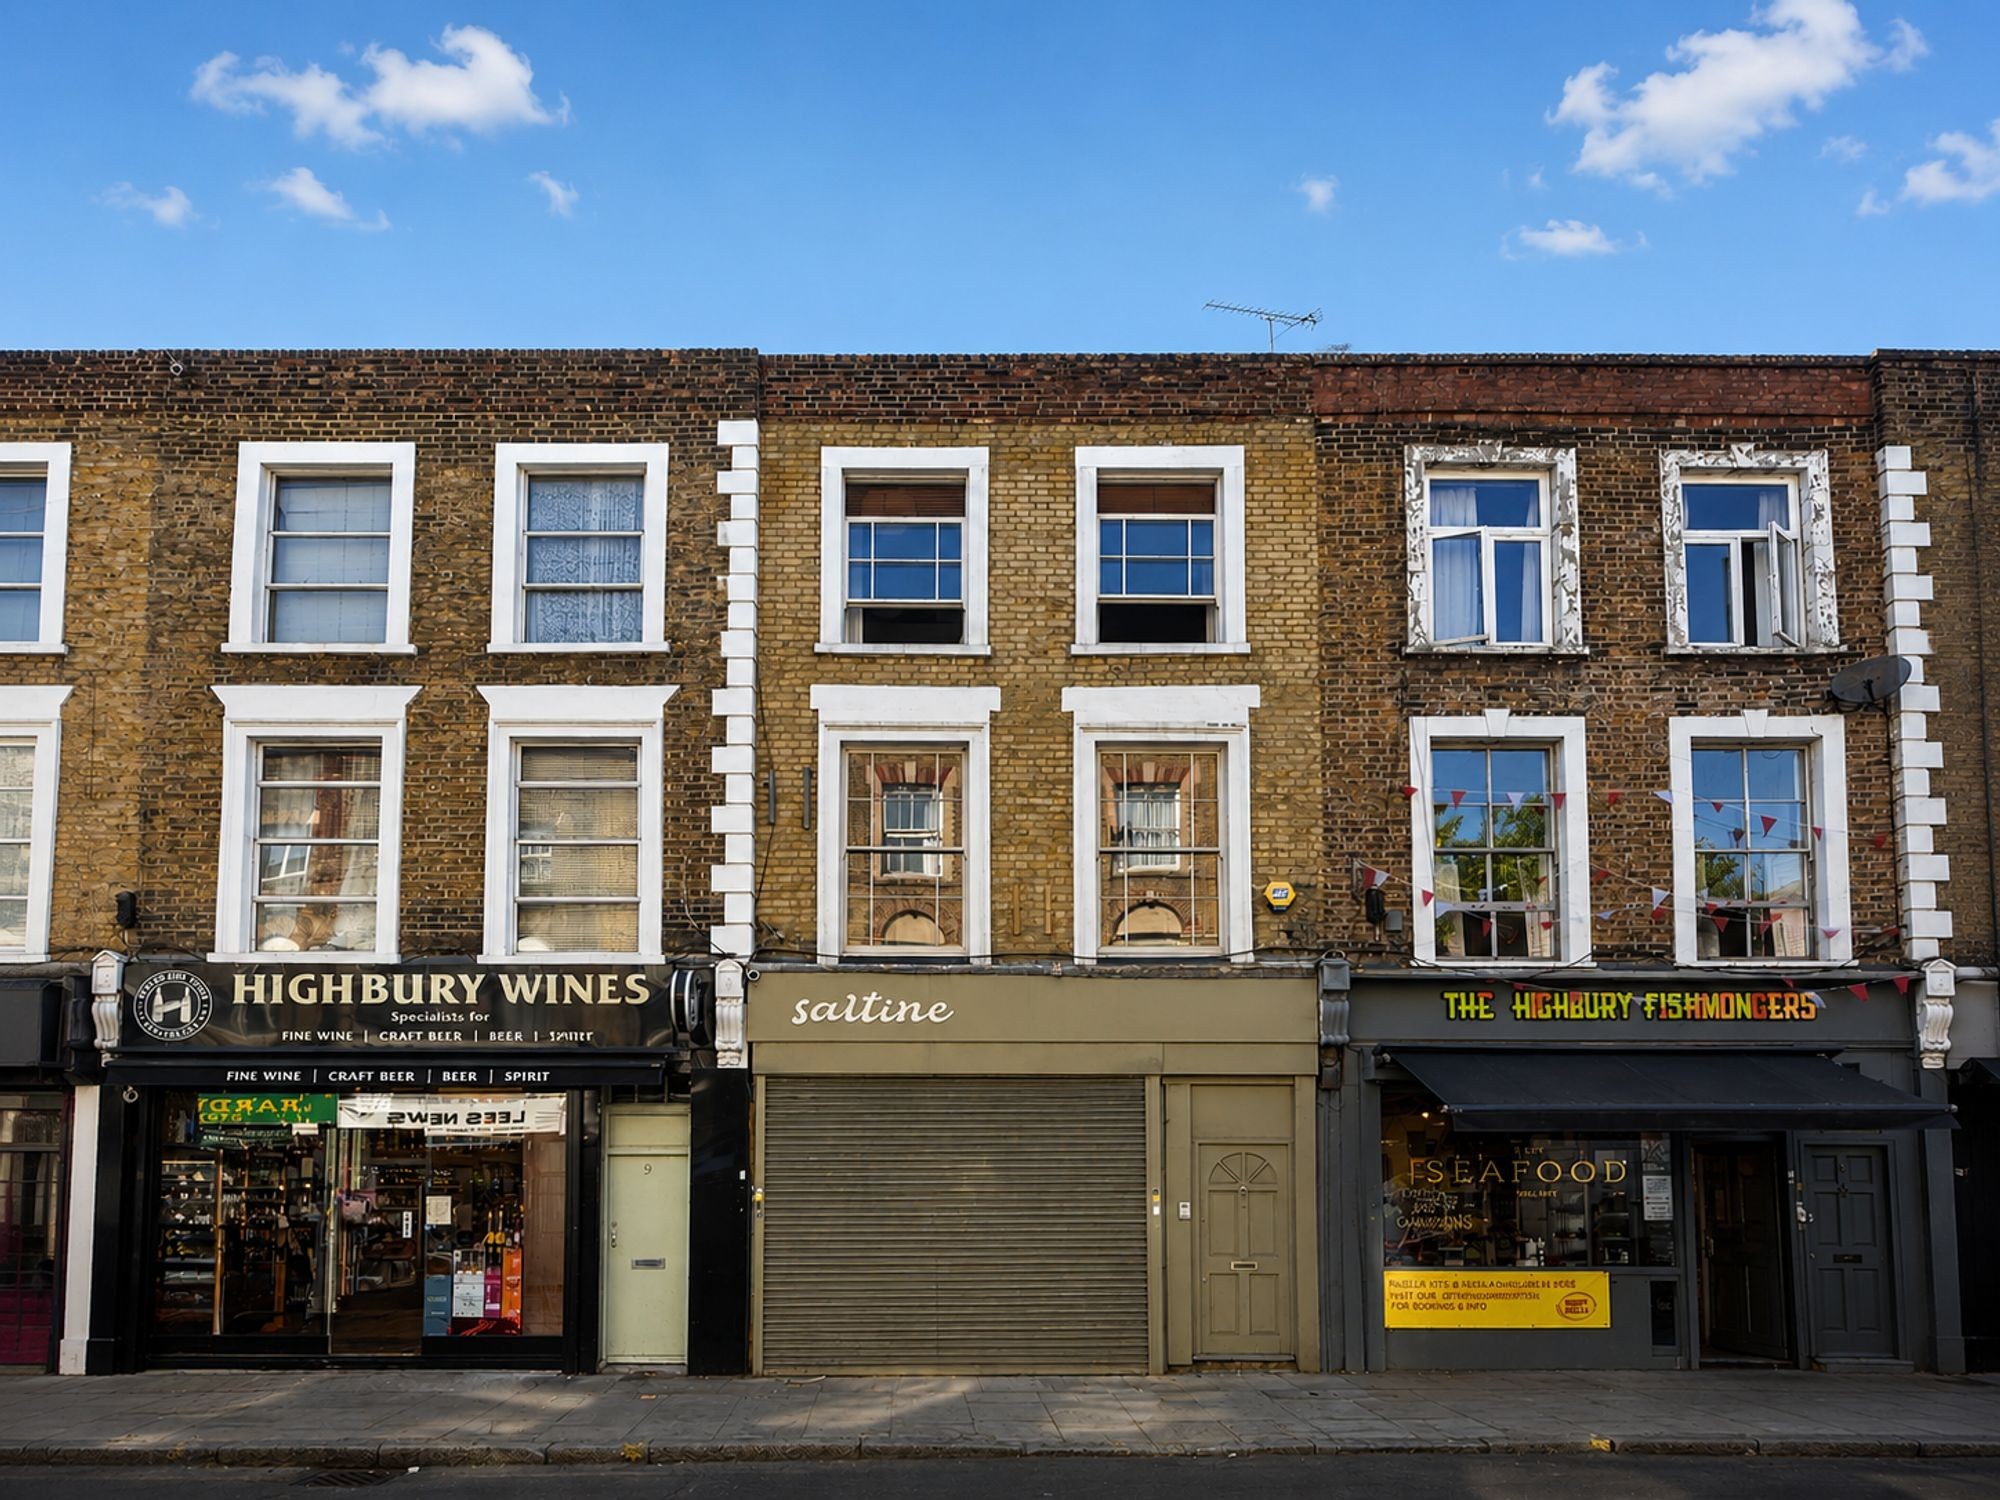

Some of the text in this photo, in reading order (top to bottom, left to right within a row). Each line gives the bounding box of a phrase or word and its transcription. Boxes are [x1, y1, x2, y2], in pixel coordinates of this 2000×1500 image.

[232, 973, 486, 1005] HIGHBURY
[498, 973, 651, 1005] WINES
[791, 991, 954, 1025] saltine
[1442, 991, 1818, 1020] THE HIGHBURY FISHMONGERS
[469, 1010, 490, 1022] for
[281, 1030, 523, 1041] FINE WINE CRAFT BEER BEER
[226, 1070, 550, 1082] FINE WINE CRAFT BEER BEER SPIRIT
[643, 1163, 653, 1176] 9
